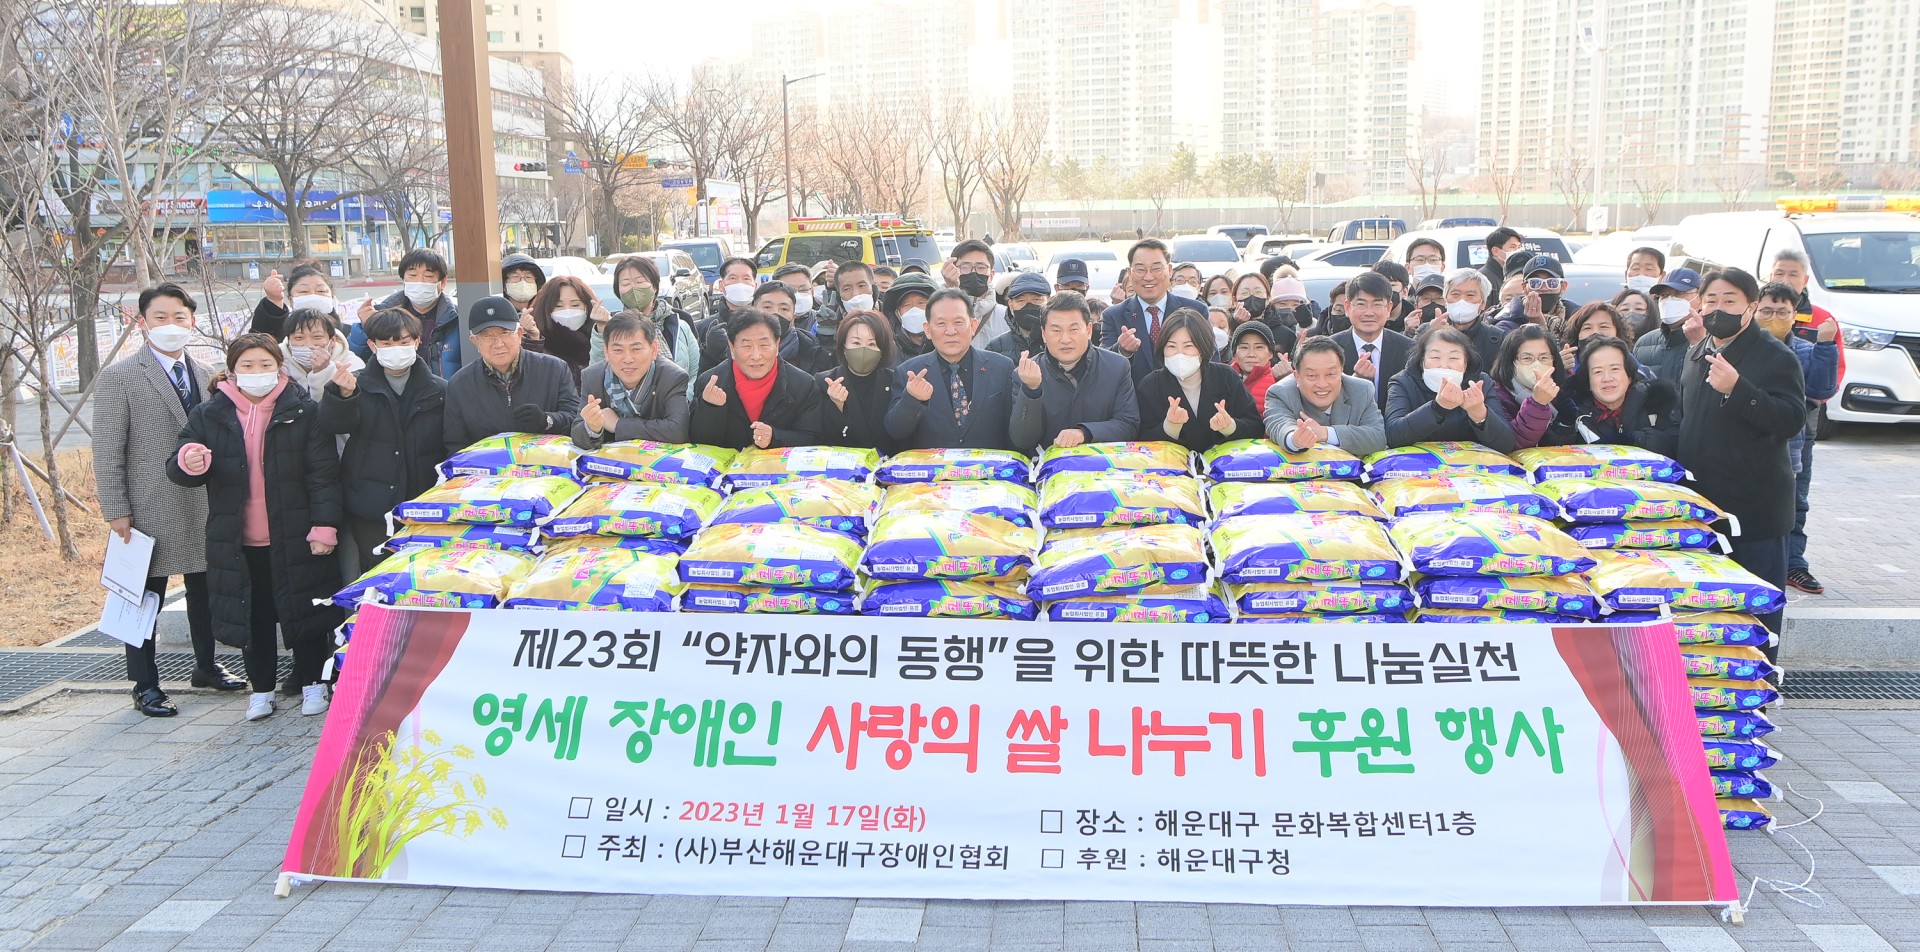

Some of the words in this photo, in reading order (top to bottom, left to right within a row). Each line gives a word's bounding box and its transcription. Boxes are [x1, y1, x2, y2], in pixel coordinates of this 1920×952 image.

[513, 629, 661, 672] 제23회
[1074, 637, 1164, 684] 위한
[1181, 639, 1317, 685] 따뜻한
[1334, 640, 1521, 685] 나눔실천
[472, 693, 588, 761] 영세
[609, 698, 782, 767] 장애인
[806, 702, 980, 773] 사랑의
[1006, 706, 1068, 774] 쌀
[1089, 707, 1266, 777] 나누기
[1293, 707, 1415, 778] 후원
[1435, 706, 1565, 775] 행사
[603, 797, 653, 823] 일시
[679, 801, 764, 827] 2023년
[776, 804, 814, 829] 1월
[827, 805, 926, 833] 17일(화)
[1076, 809, 1126, 836] 장소
[1155, 810, 1259, 837] 해운대구
[1272, 811, 1477, 838] 문화복합센터1층
[597, 835, 646, 863] 주최
[675, 837, 1008, 871] (사)부산해운대구장애인협회
[1077, 848, 1127, 871] 후원
[1157, 848, 1290, 875] 해운대구청
